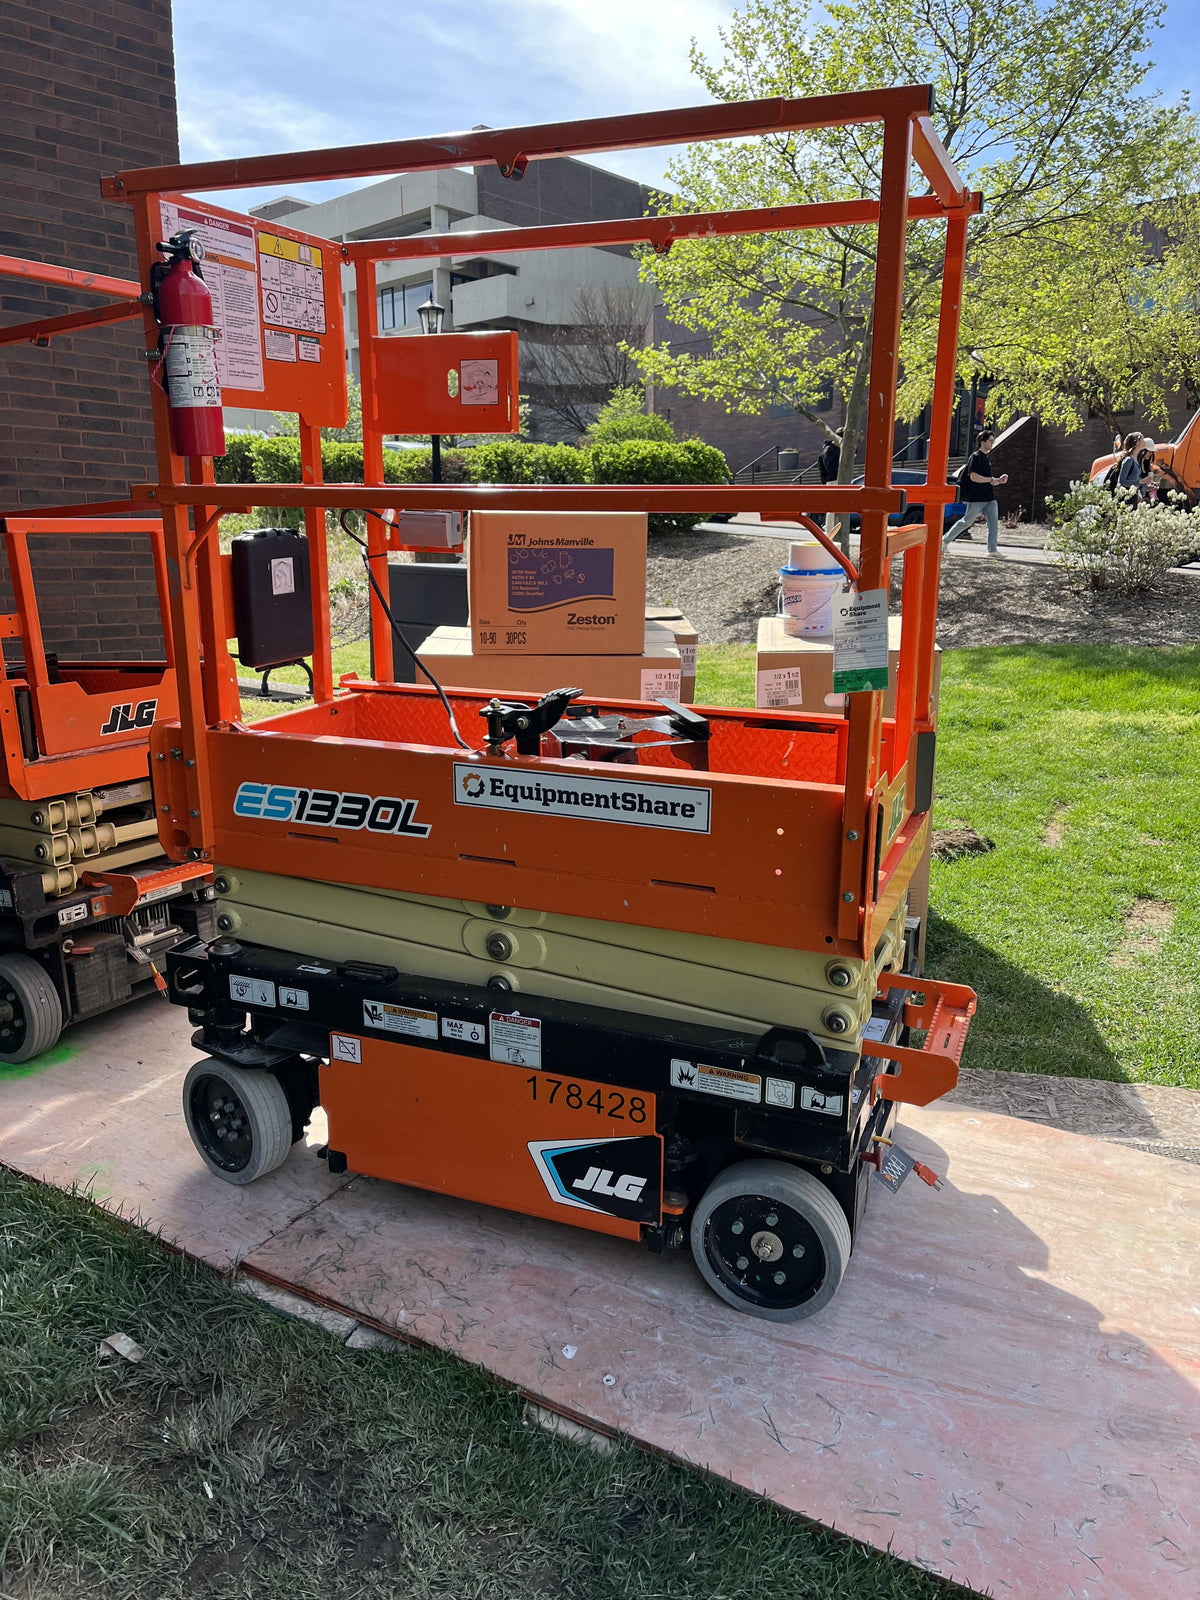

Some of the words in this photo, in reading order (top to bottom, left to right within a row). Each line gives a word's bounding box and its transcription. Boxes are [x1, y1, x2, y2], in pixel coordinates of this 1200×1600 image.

[209, 218, 230, 231] DANGER
[527, 537, 554, 547] Johns
[555, 537, 595, 546] Manville
[849, 603, 881, 611] Equipment
[567, 613, 616, 625] Zeston
[479, 632, 497, 645] 10-90
[506, 632, 527, 645] 30PCS
[100, 698, 158, 736] JLG
[489, 777, 697, 819] EquipmentShare
[233, 781, 432, 839] ES1330L
[398, 1006, 428, 1019] WARNING
[446, 1020, 464, 1031] MAX
[506, 1016, 533, 1027] DANGER
[717, 1069, 749, 1081] WARNING
[526, 1075, 647, 1124] 178428
[571, 1166, 648, 1202] JLG
